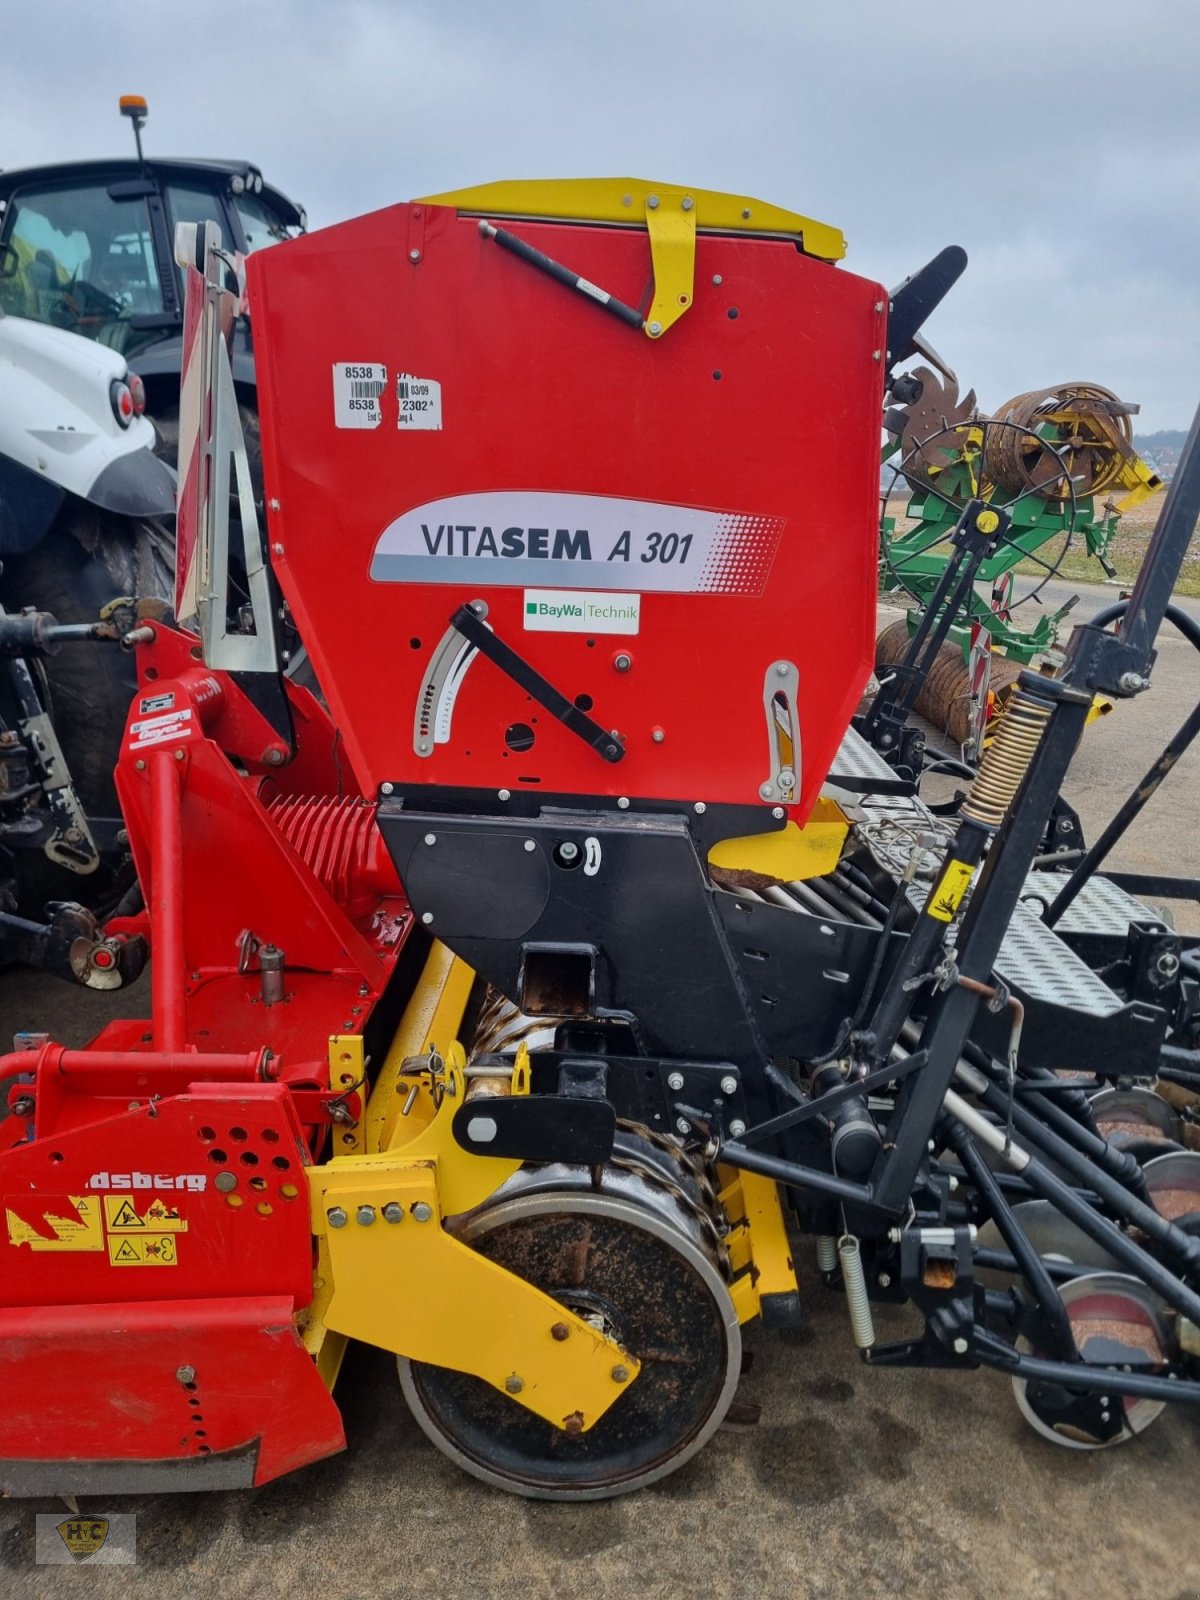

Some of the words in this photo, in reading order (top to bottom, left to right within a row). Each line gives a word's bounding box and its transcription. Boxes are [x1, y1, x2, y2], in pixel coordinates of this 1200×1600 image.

[345, 367, 373, 379] 8538
[410, 385, 429, 396] 03/09
[349, 399, 375, 410] 8538
[402, 400, 428, 412] 2302
[398, 413, 408, 424] ang
[421, 524, 593, 561] VITASEM
[607, 530, 632, 562] A
[640, 532, 694, 564] 301
[539, 603, 583, 617] BayWa
[587, 604, 638, 619] Technik
[86, 1171, 207, 1192] dsberg
